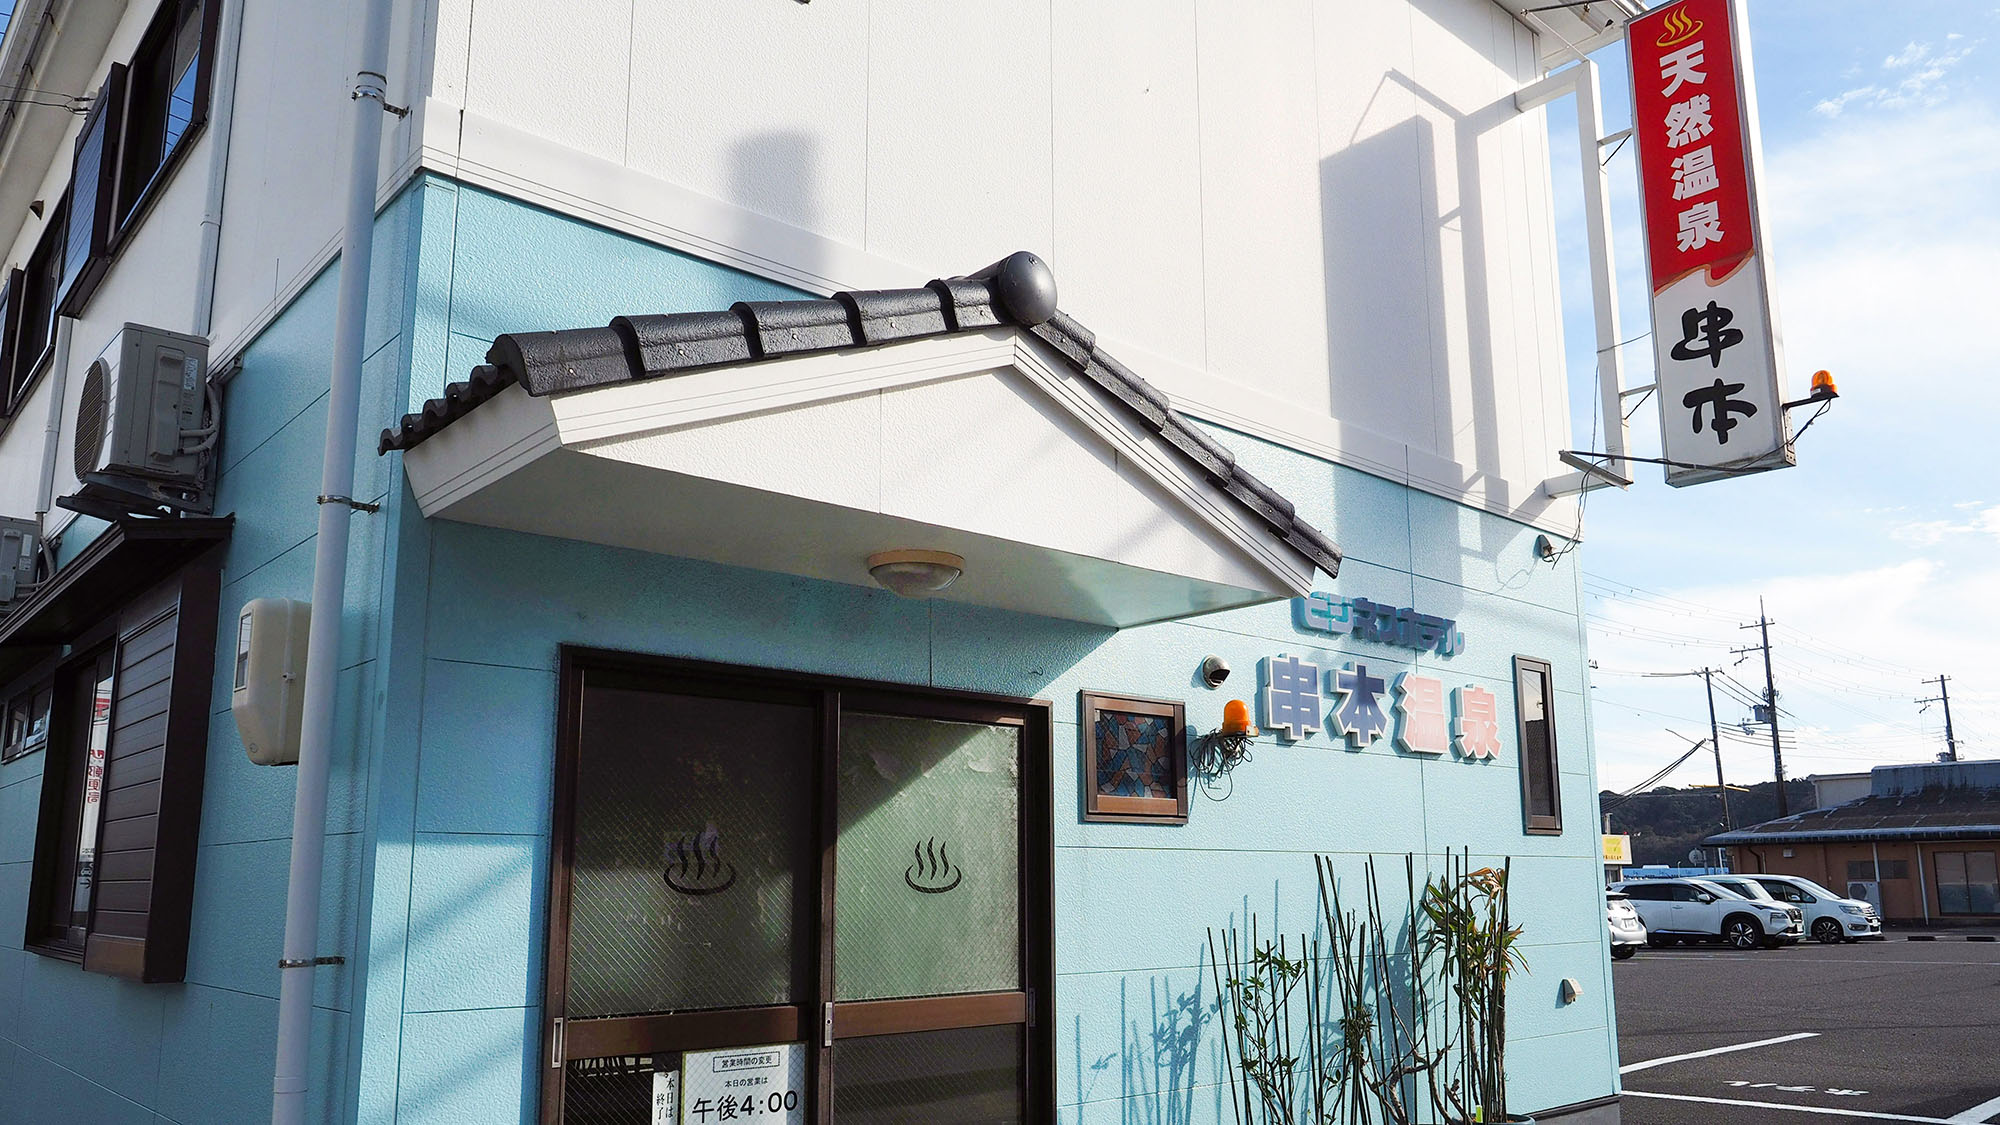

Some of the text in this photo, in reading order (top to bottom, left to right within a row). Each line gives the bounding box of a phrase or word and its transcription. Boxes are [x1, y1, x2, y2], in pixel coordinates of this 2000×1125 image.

[1659, 39, 1725, 252] 天然温泉
[1670, 300, 1758, 446] 串本
[1263, 653, 1503, 761] 串本温泉
[721, 1055, 773, 1069] 営業時間の変更
[666, 1077, 675, 1118] 本日は
[724, 1076, 768, 1088] 本日の営業は
[656, 1093, 665, 1125] 終了
[692, 1090, 798, 1124] 午後4:00
